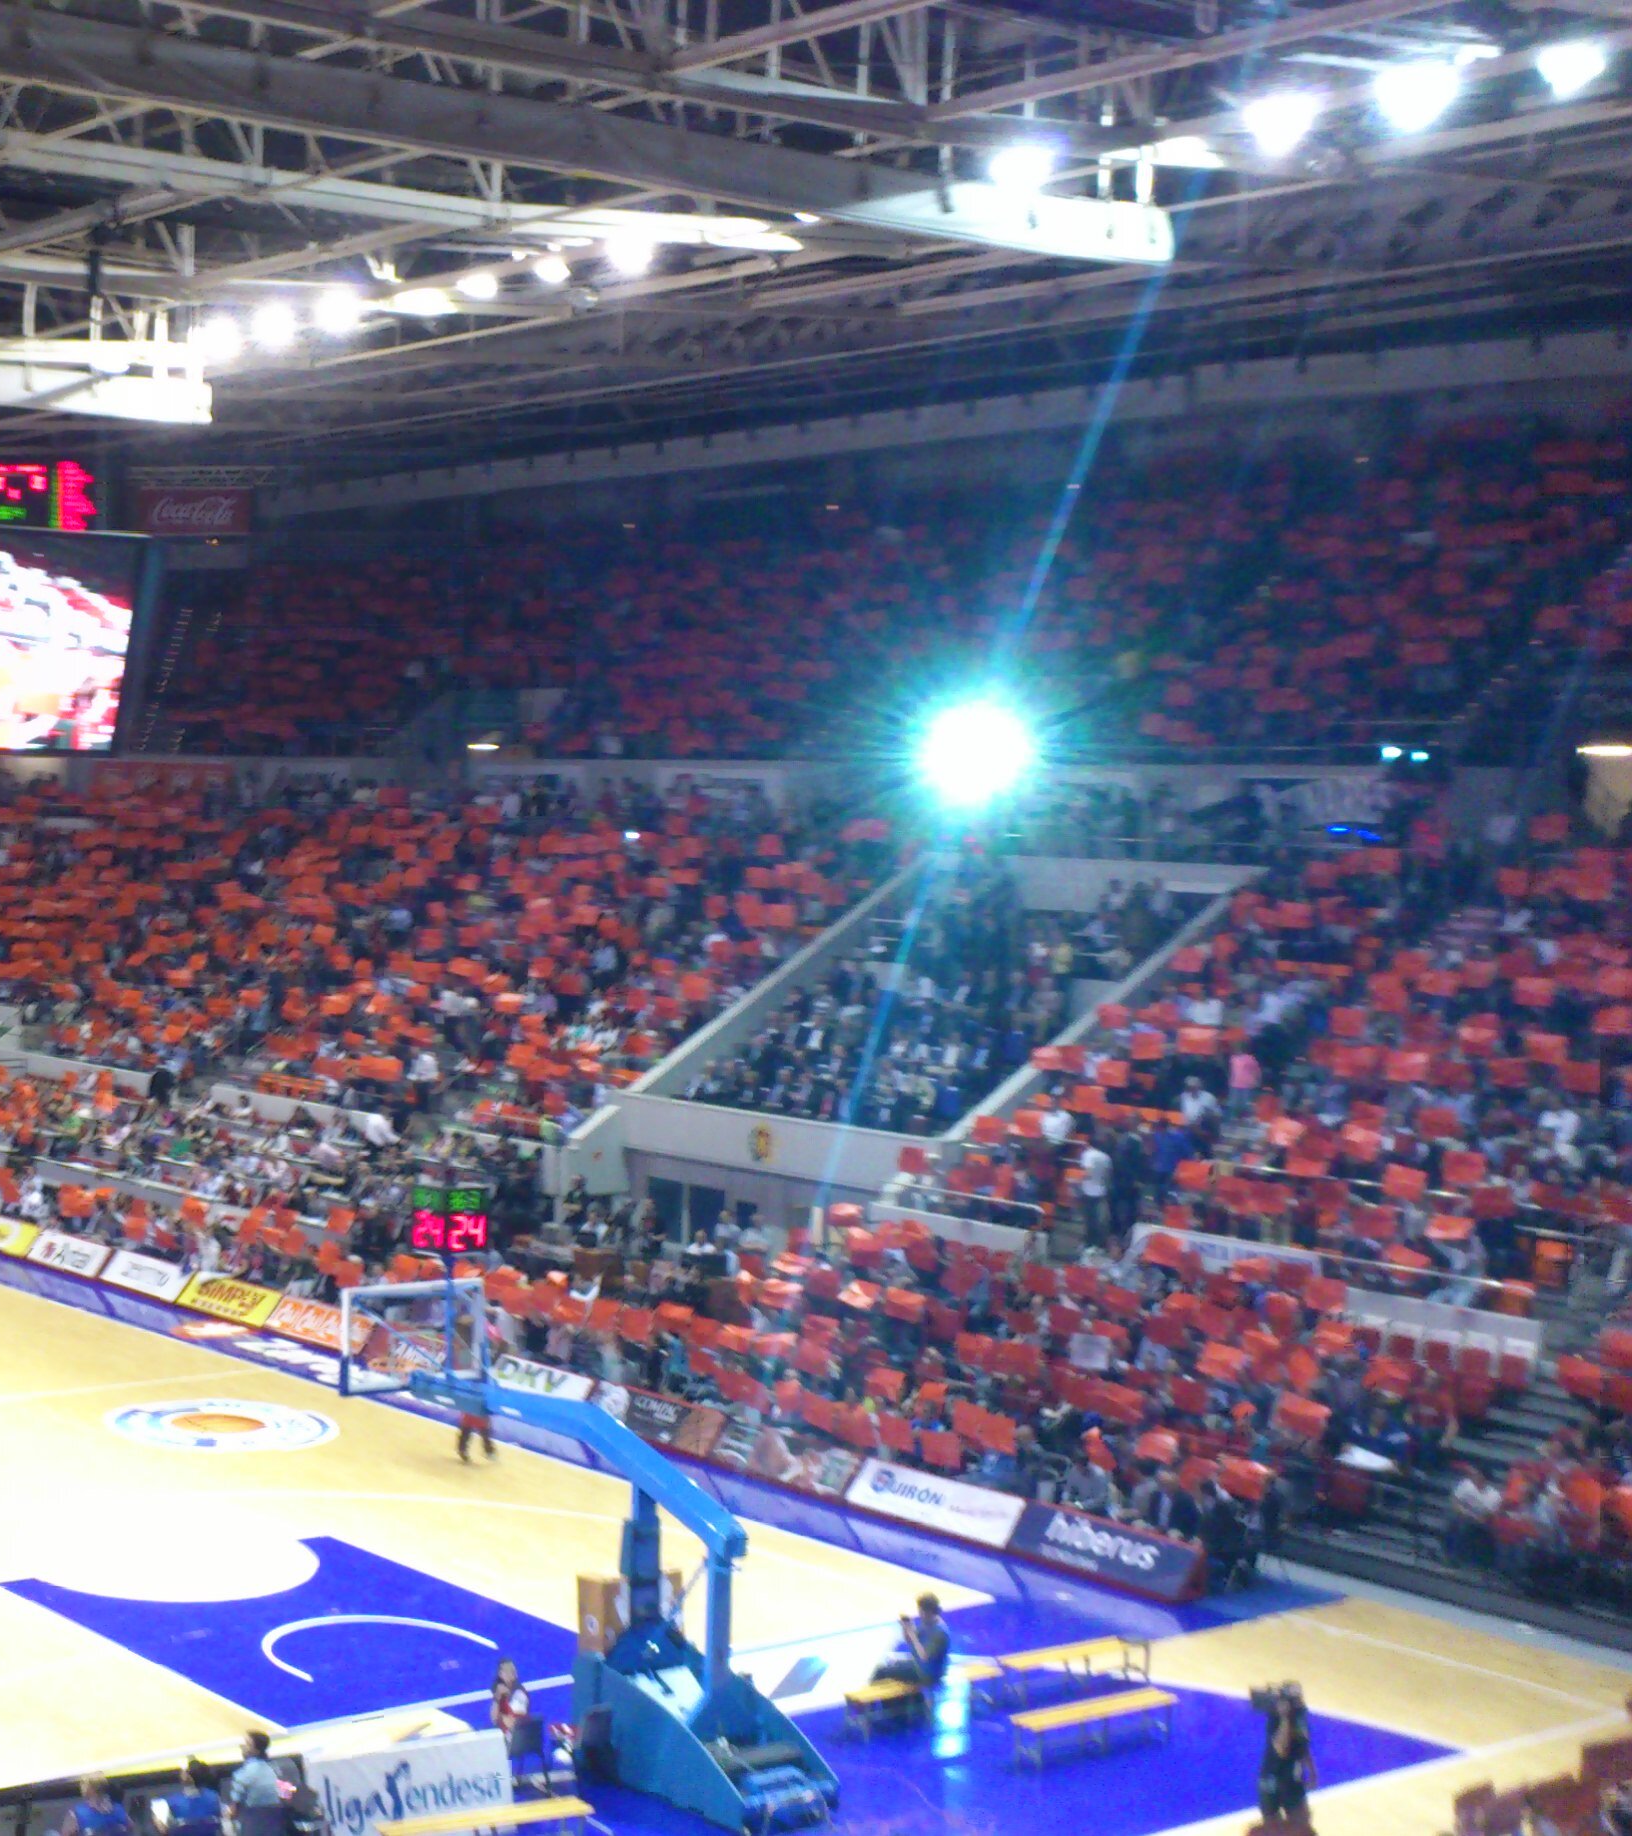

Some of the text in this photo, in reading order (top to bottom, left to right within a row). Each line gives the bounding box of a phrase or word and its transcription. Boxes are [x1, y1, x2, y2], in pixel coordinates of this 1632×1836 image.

[412, 1210, 487, 1252] 24 24
[495, 1355, 569, 1393] DKV
[1044, 1511, 1161, 1570] hiberus
